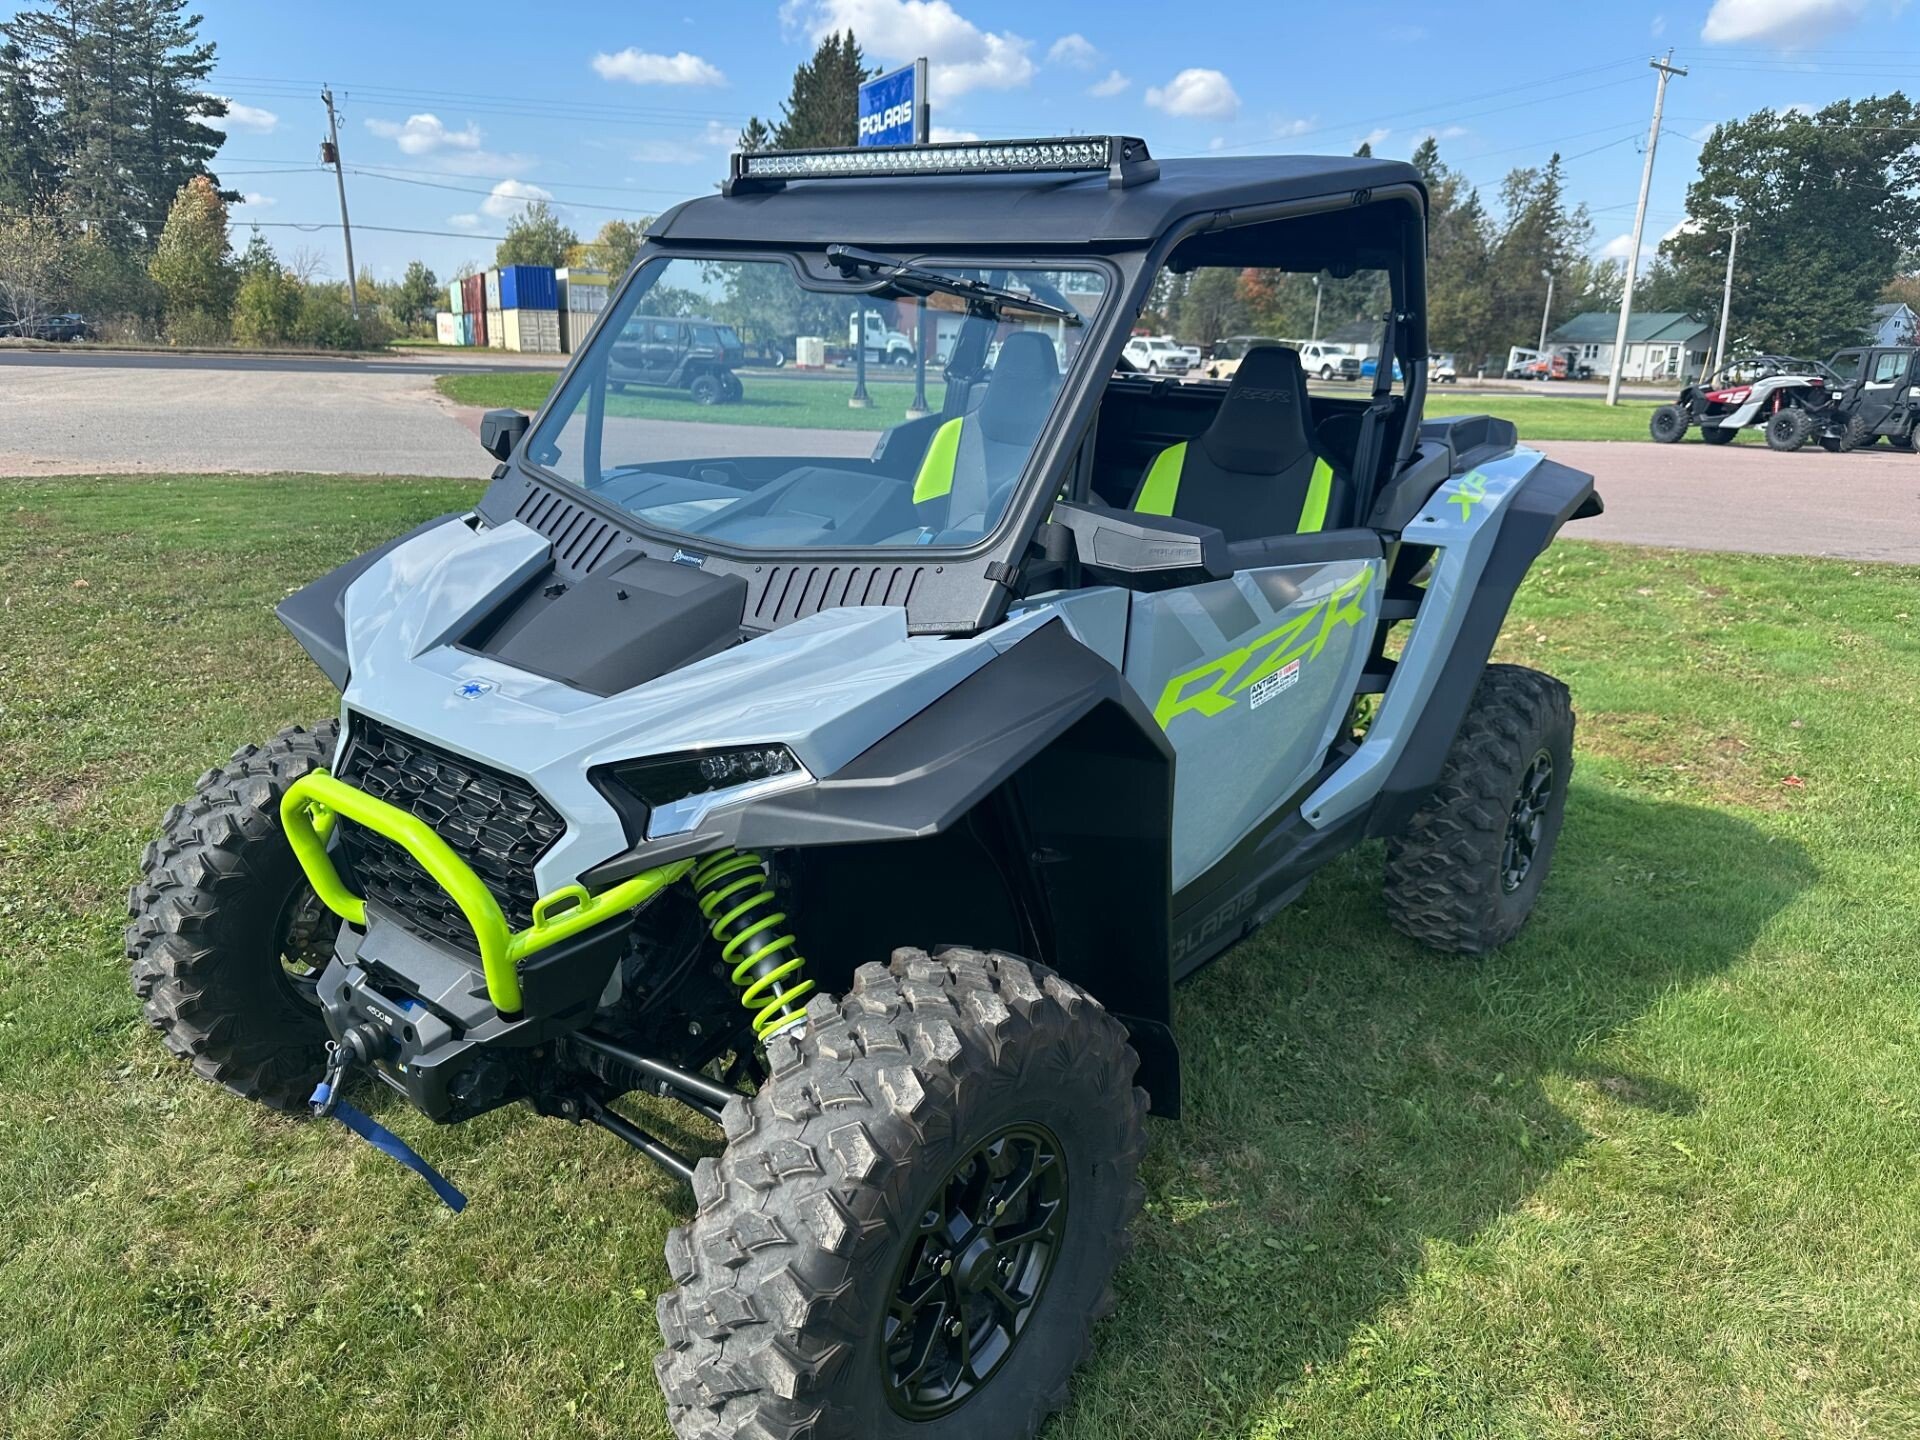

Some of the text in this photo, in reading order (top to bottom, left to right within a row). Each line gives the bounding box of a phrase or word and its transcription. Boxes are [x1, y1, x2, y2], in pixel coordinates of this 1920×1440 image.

[860, 100, 912, 138] POLARIS
[1446, 470, 1488, 524] XP
[1153, 565, 1375, 732] RZR
[1172, 884, 1258, 962] OLARIS
